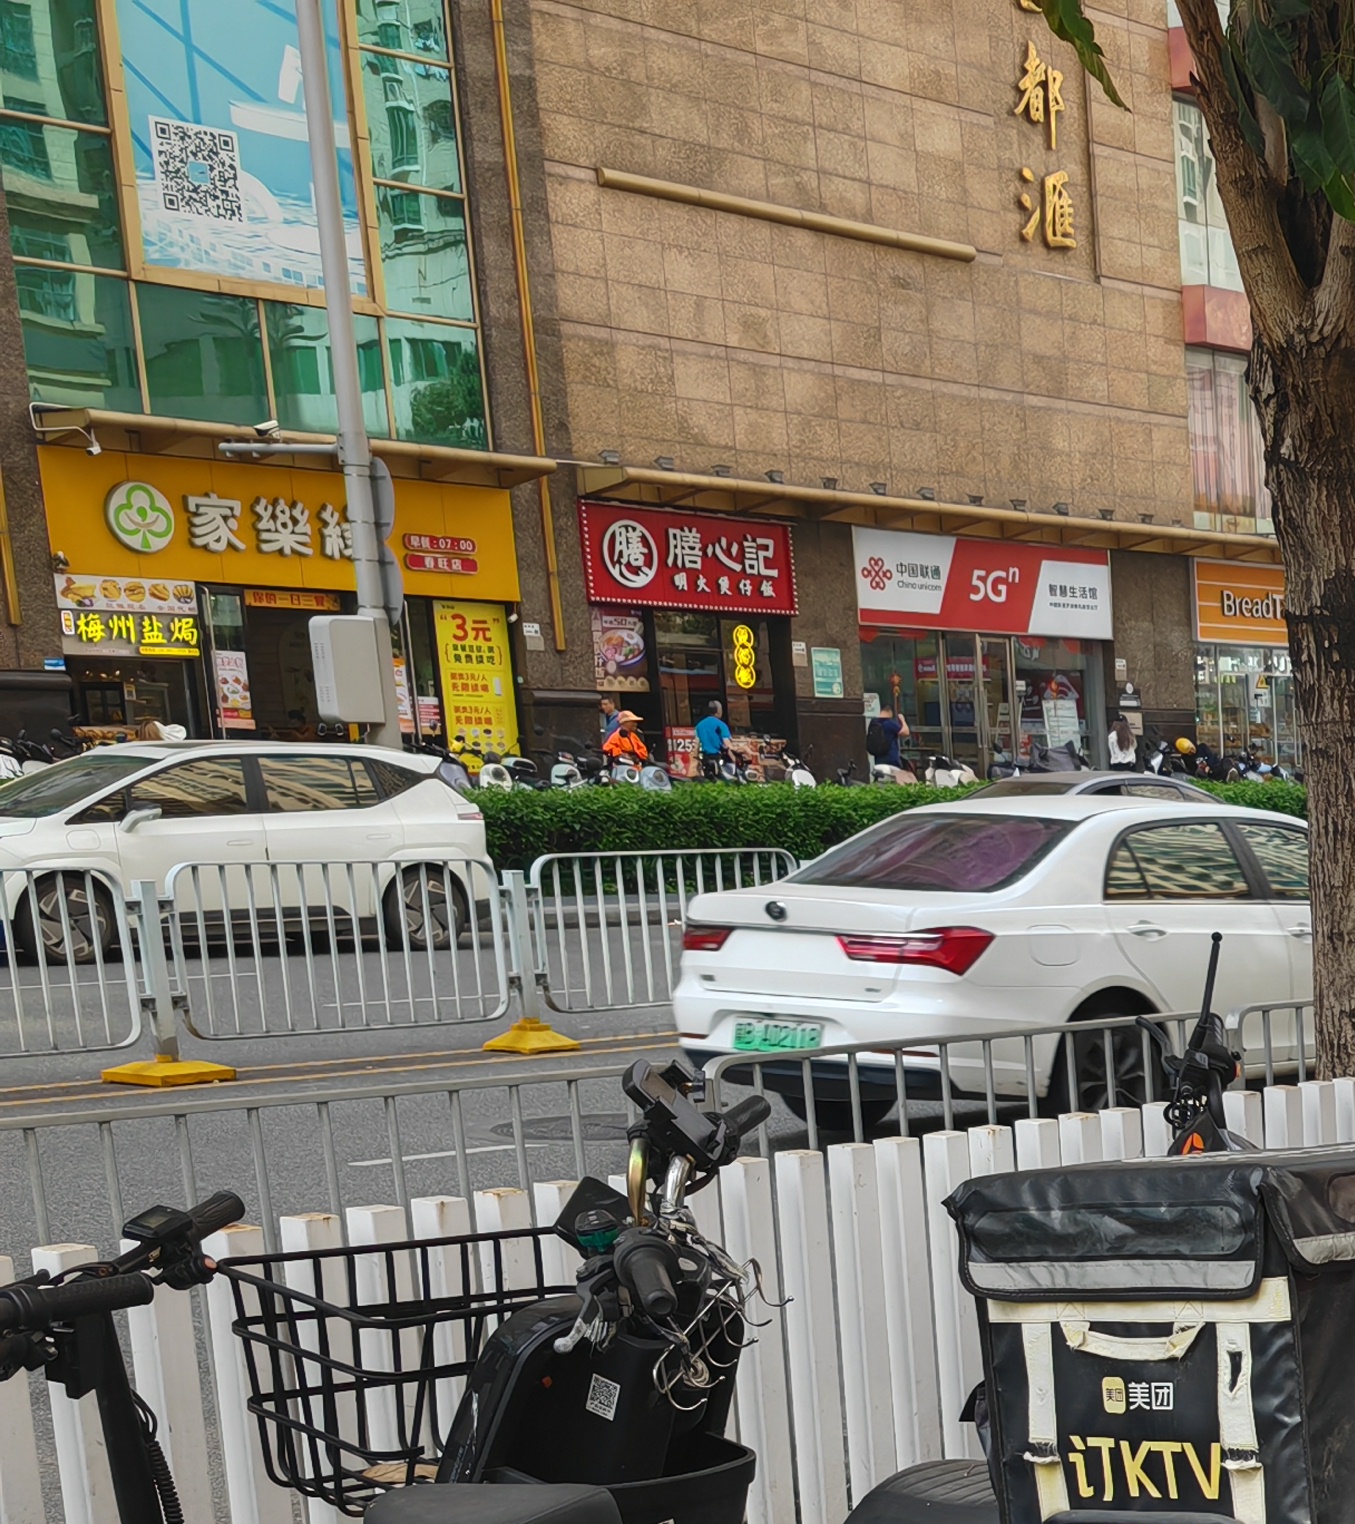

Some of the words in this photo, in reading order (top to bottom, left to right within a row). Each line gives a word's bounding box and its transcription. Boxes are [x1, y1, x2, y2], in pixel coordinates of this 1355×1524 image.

[896, 562, 941, 581] 中国联通
[76, 613, 198, 645] 梅州盐焗
[1128, 1381, 1174, 1411] 美团
[1068, 1435, 1222, 1502] 订KTV
